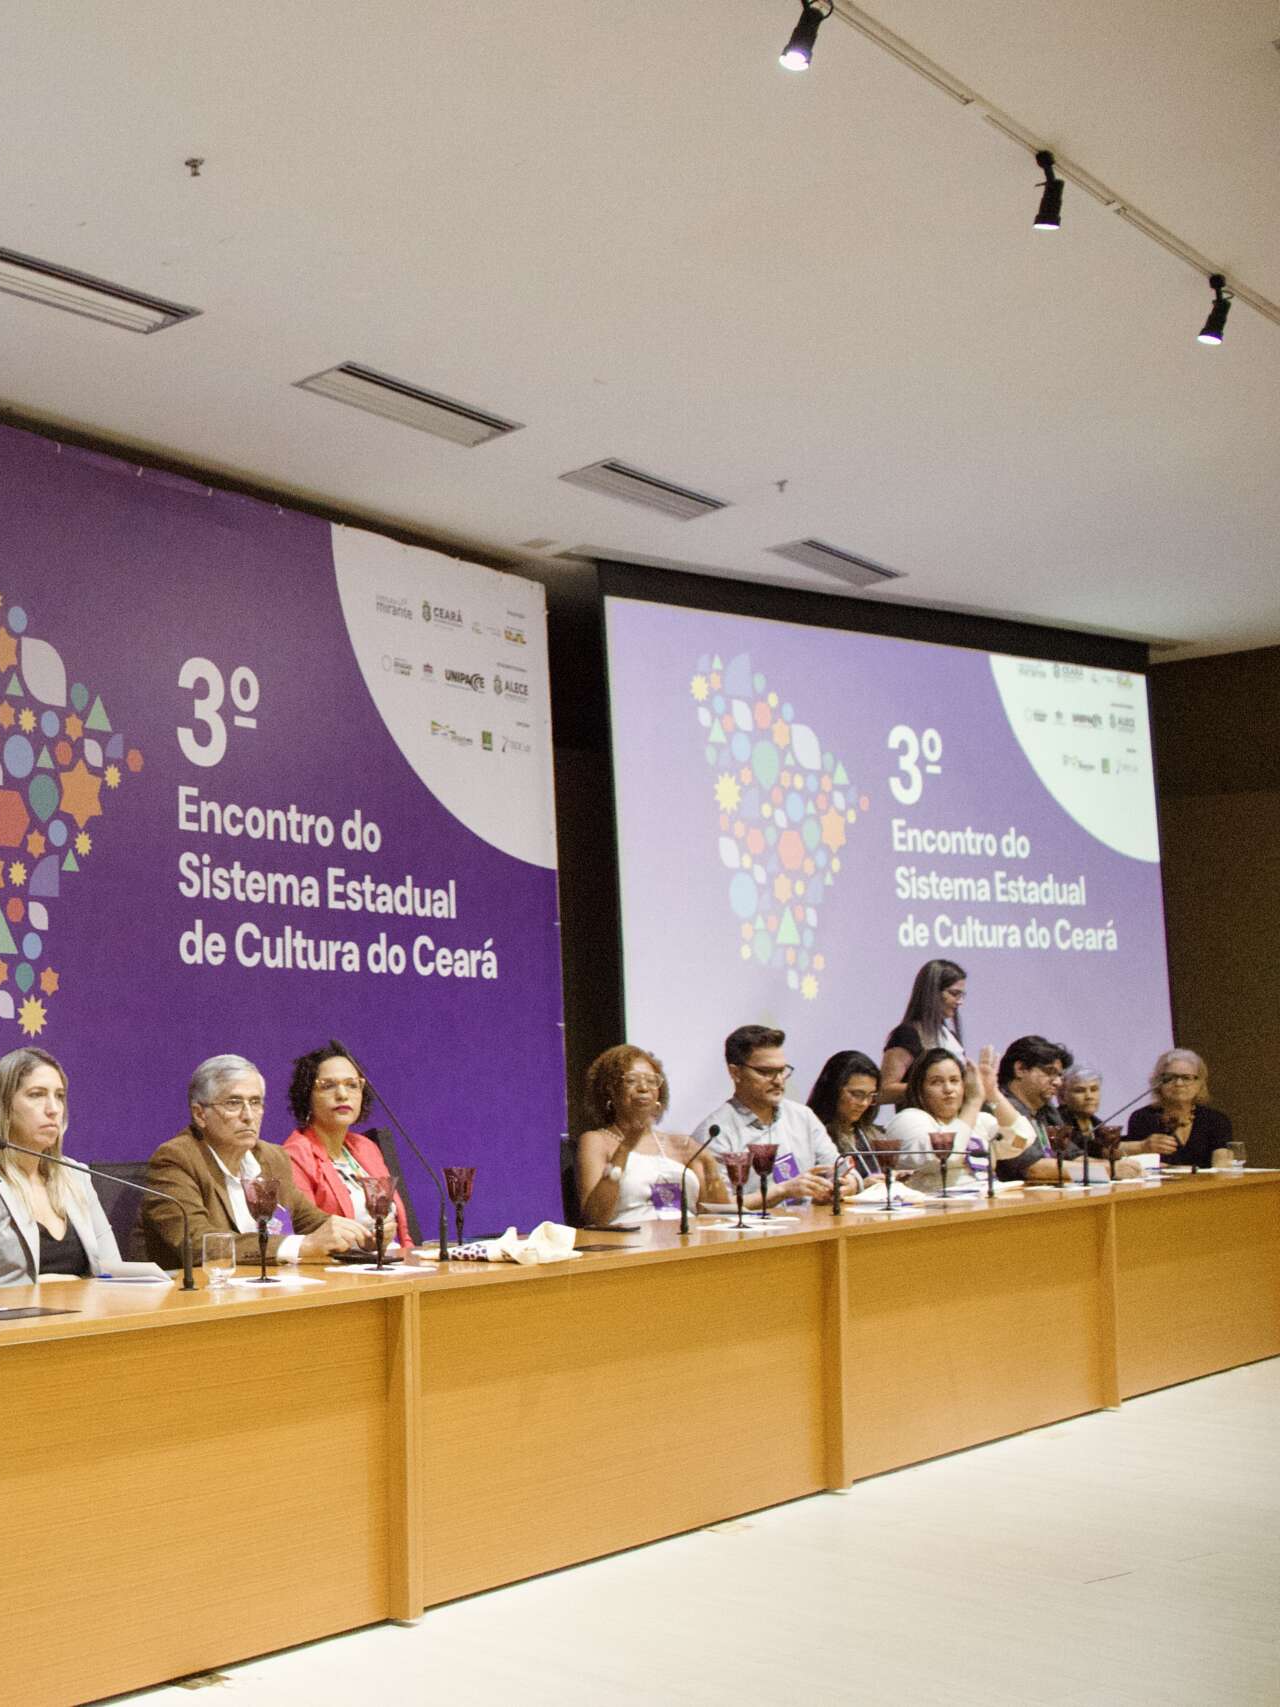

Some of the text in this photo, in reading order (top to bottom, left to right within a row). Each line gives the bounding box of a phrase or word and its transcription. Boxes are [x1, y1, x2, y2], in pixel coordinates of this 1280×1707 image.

[432, 607, 464, 624] CEARÁ
[177, 656, 260, 767] 3º
[504, 680, 529, 697] ALECE
[887, 724, 943, 805] 3º
[178, 785, 382, 852] Encontro do
[891, 818, 1031, 858] Encontro do
[178, 851, 457, 919] Sistema Estadual
[895, 866, 1086, 905] Sistema Estadual
[179, 919, 498, 979] de Cultura do Ceará
[898, 914, 1118, 950] de Cultura do Ceará
